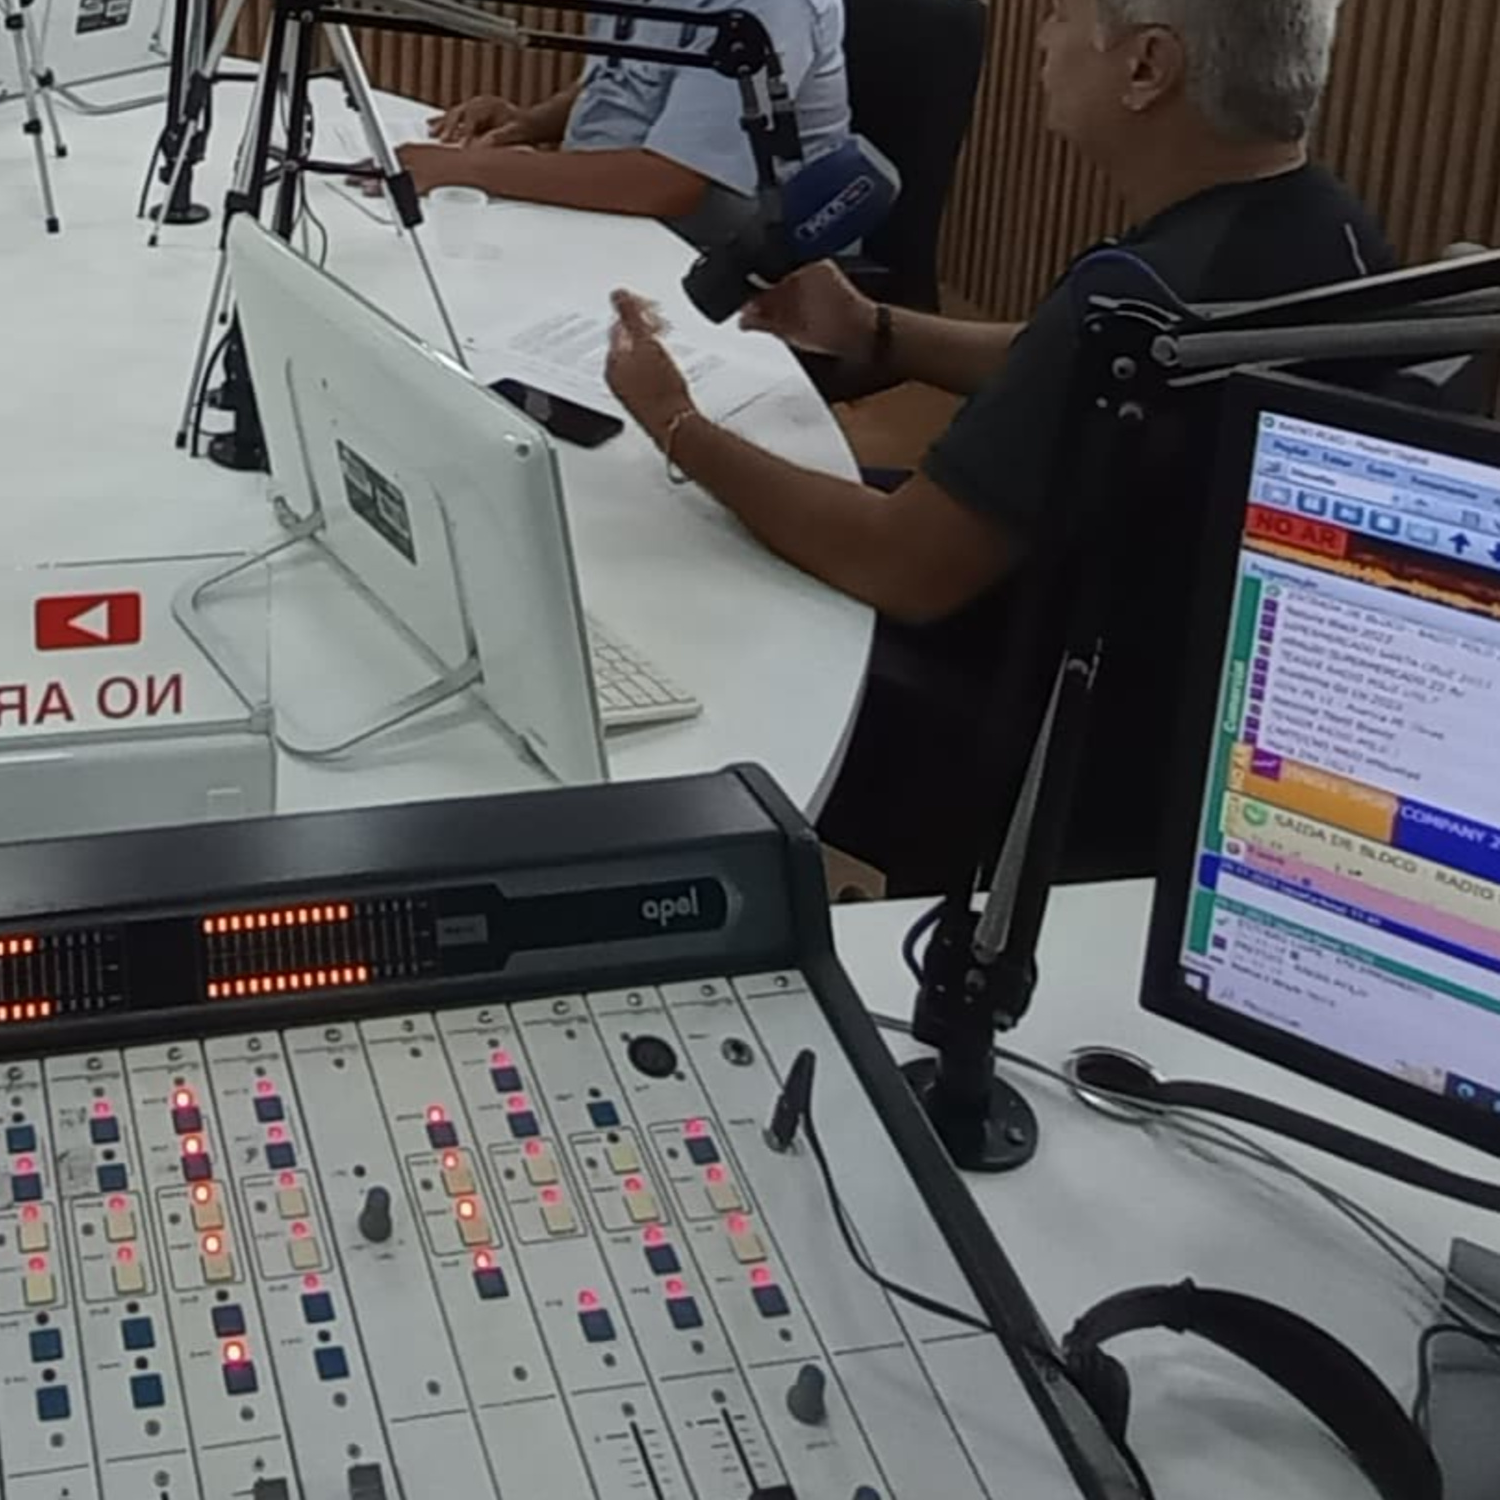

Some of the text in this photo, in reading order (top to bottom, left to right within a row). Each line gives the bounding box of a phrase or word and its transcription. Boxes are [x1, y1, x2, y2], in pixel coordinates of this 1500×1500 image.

[1255, 512, 1337, 549] NO AR
[1401, 806, 1487, 843] COMPANY
[1435, 870, 1495, 901] RADIO
